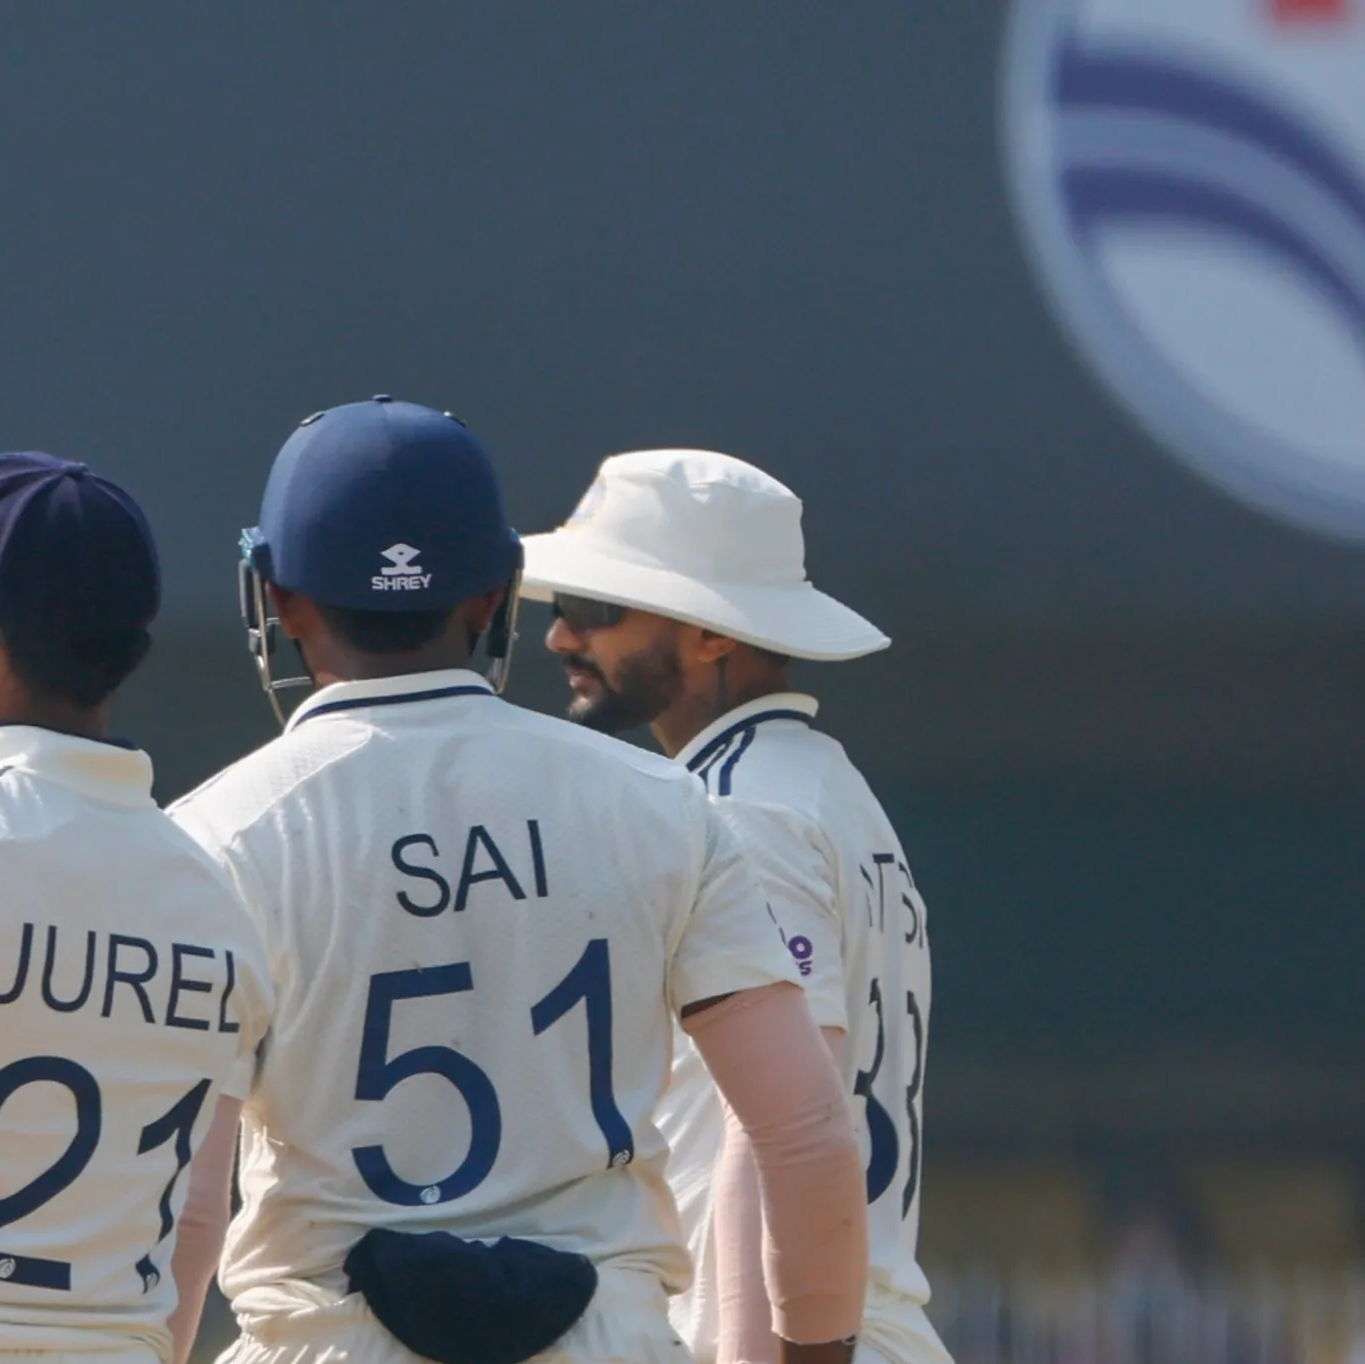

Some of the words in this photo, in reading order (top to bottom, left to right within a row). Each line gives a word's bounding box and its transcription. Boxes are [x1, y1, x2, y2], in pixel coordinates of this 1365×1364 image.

[371, 573, 432, 591] SHREY
[390, 820, 548, 917] SAI
[351, 937, 635, 1207] 51
